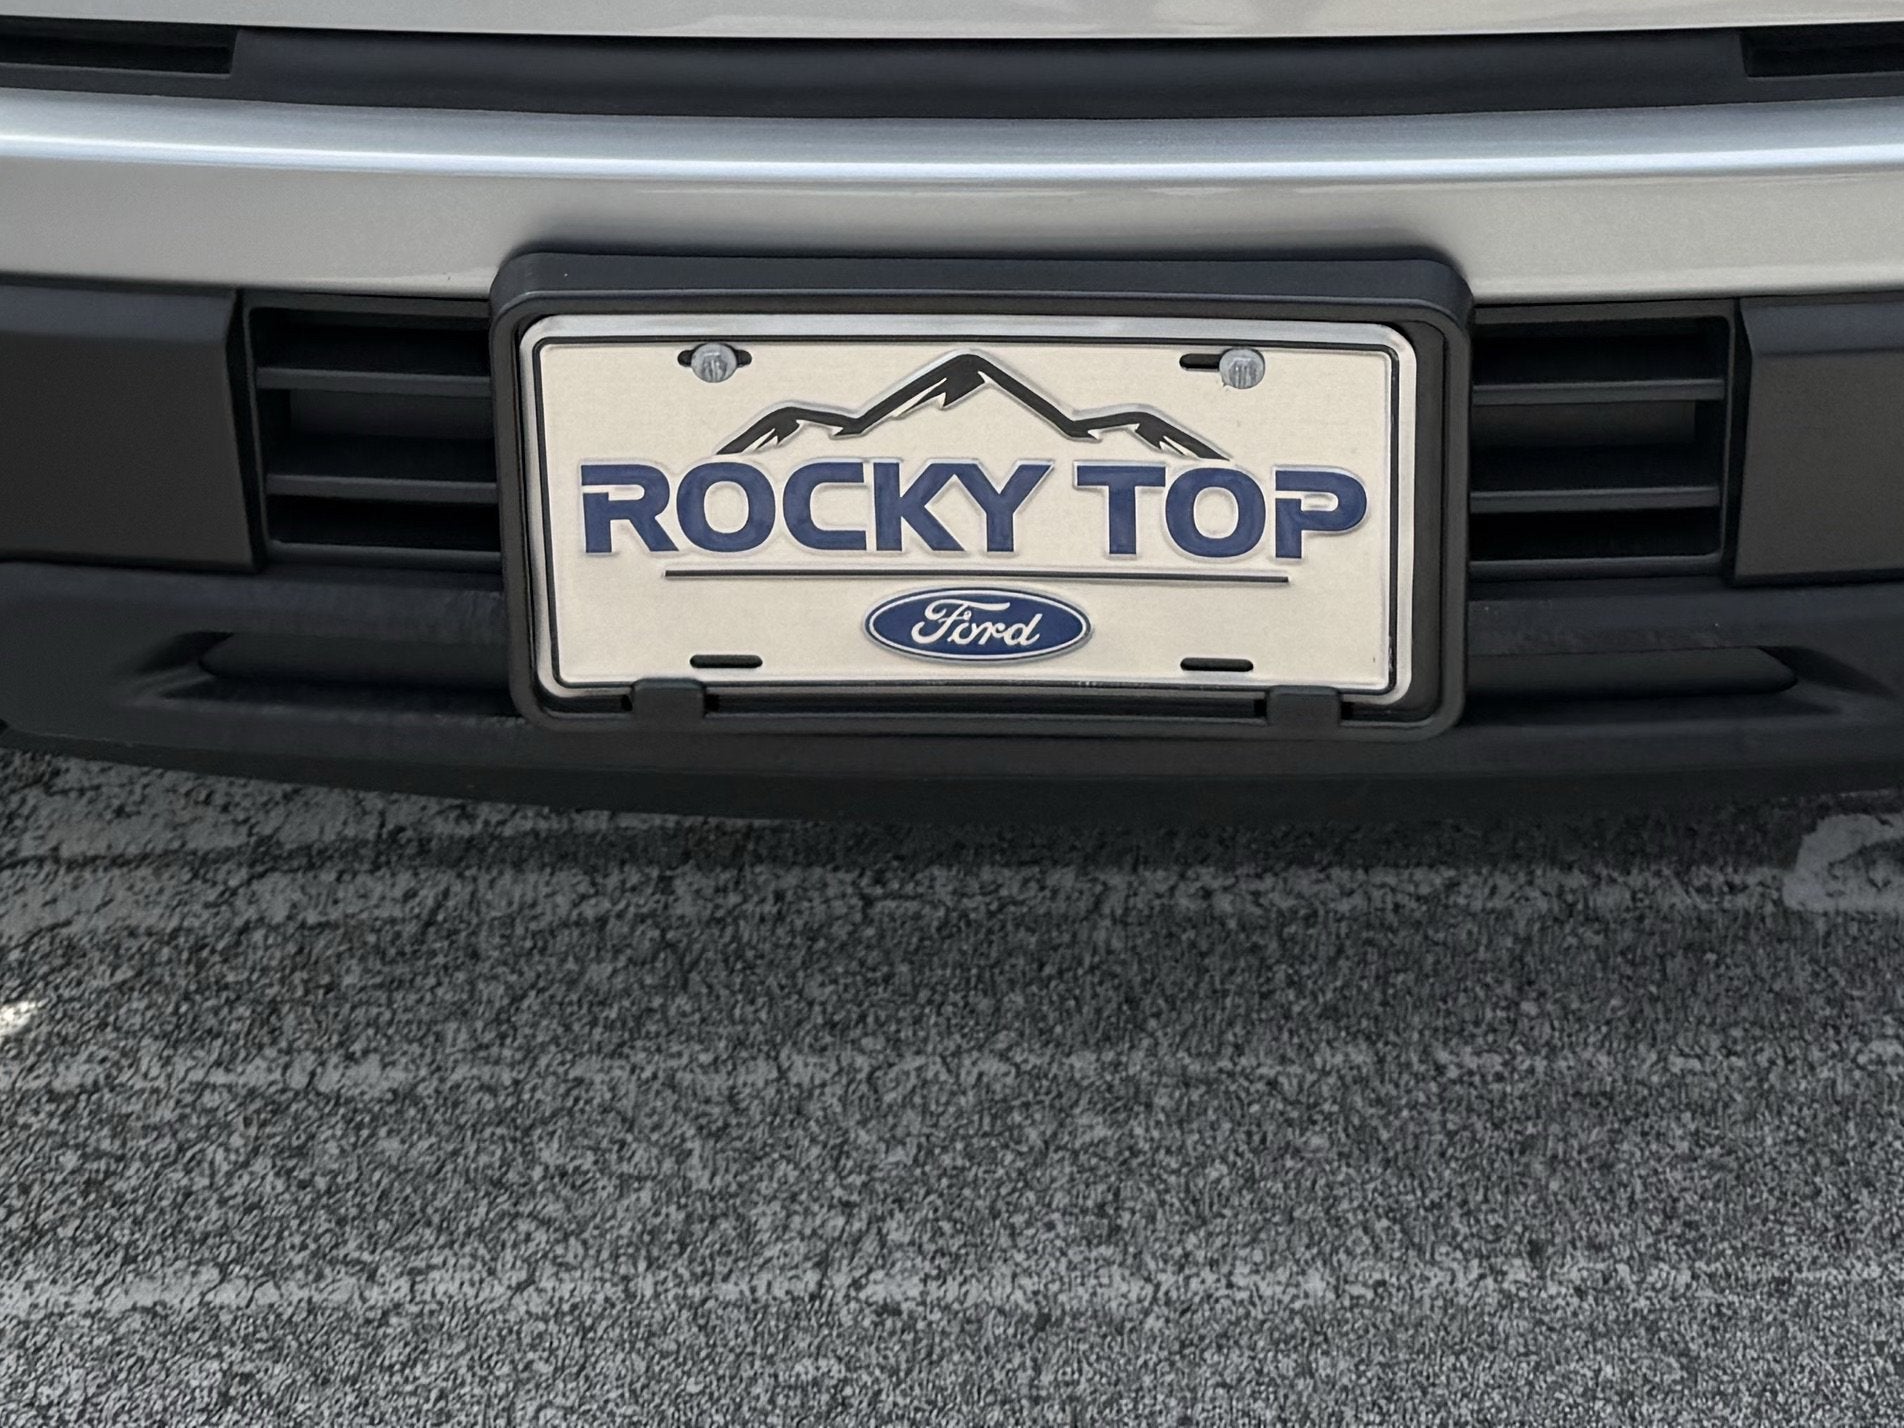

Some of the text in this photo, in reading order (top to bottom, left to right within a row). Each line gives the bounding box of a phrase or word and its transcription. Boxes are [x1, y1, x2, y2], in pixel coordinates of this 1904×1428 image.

[580, 462, 1368, 559] ROCKY TOP
[912, 590, 1042, 646] Ford
